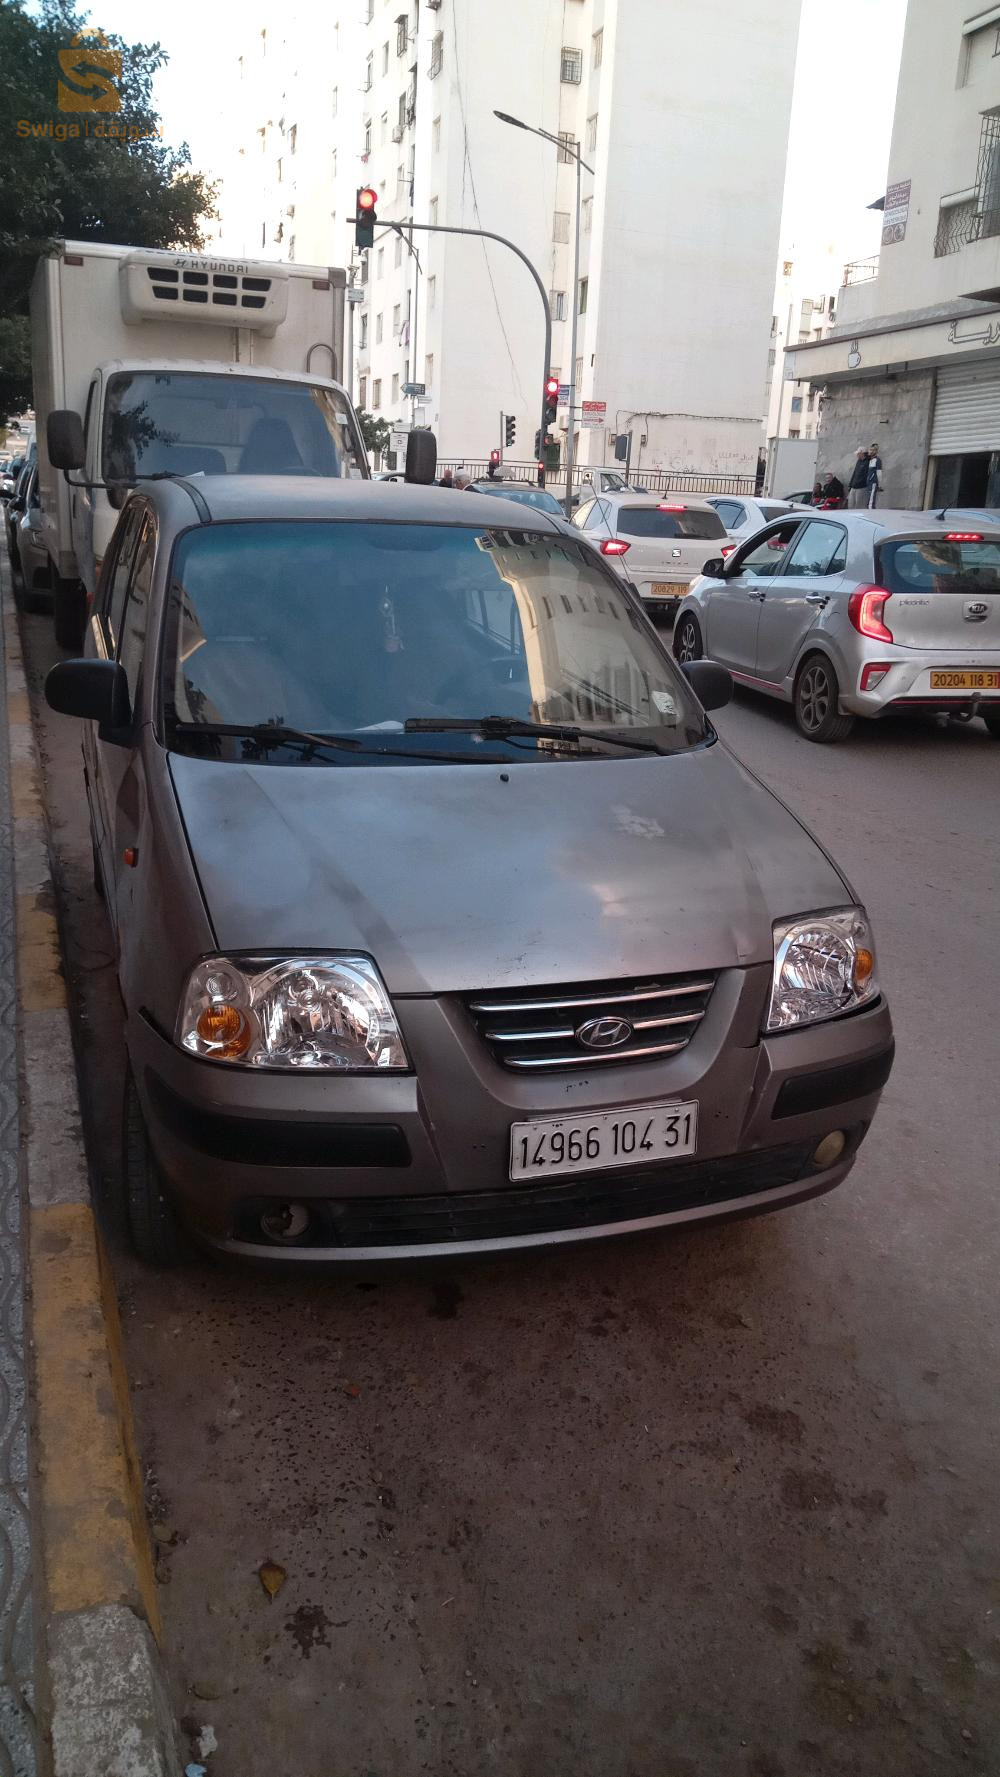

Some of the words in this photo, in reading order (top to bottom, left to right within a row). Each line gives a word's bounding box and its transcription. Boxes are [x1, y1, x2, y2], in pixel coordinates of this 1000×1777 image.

[191, 260, 249, 274] HYUNDAI
[653, 584, 675, 594] 20829
[933, 673, 965, 686] 20204
[970, 673, 984, 686] 118
[987, 673, 997, 686] 31
[520, 1126, 600, 1168] 14966
[611, 1115, 654, 1155] 104
[664, 1112, 692, 1148] 31
